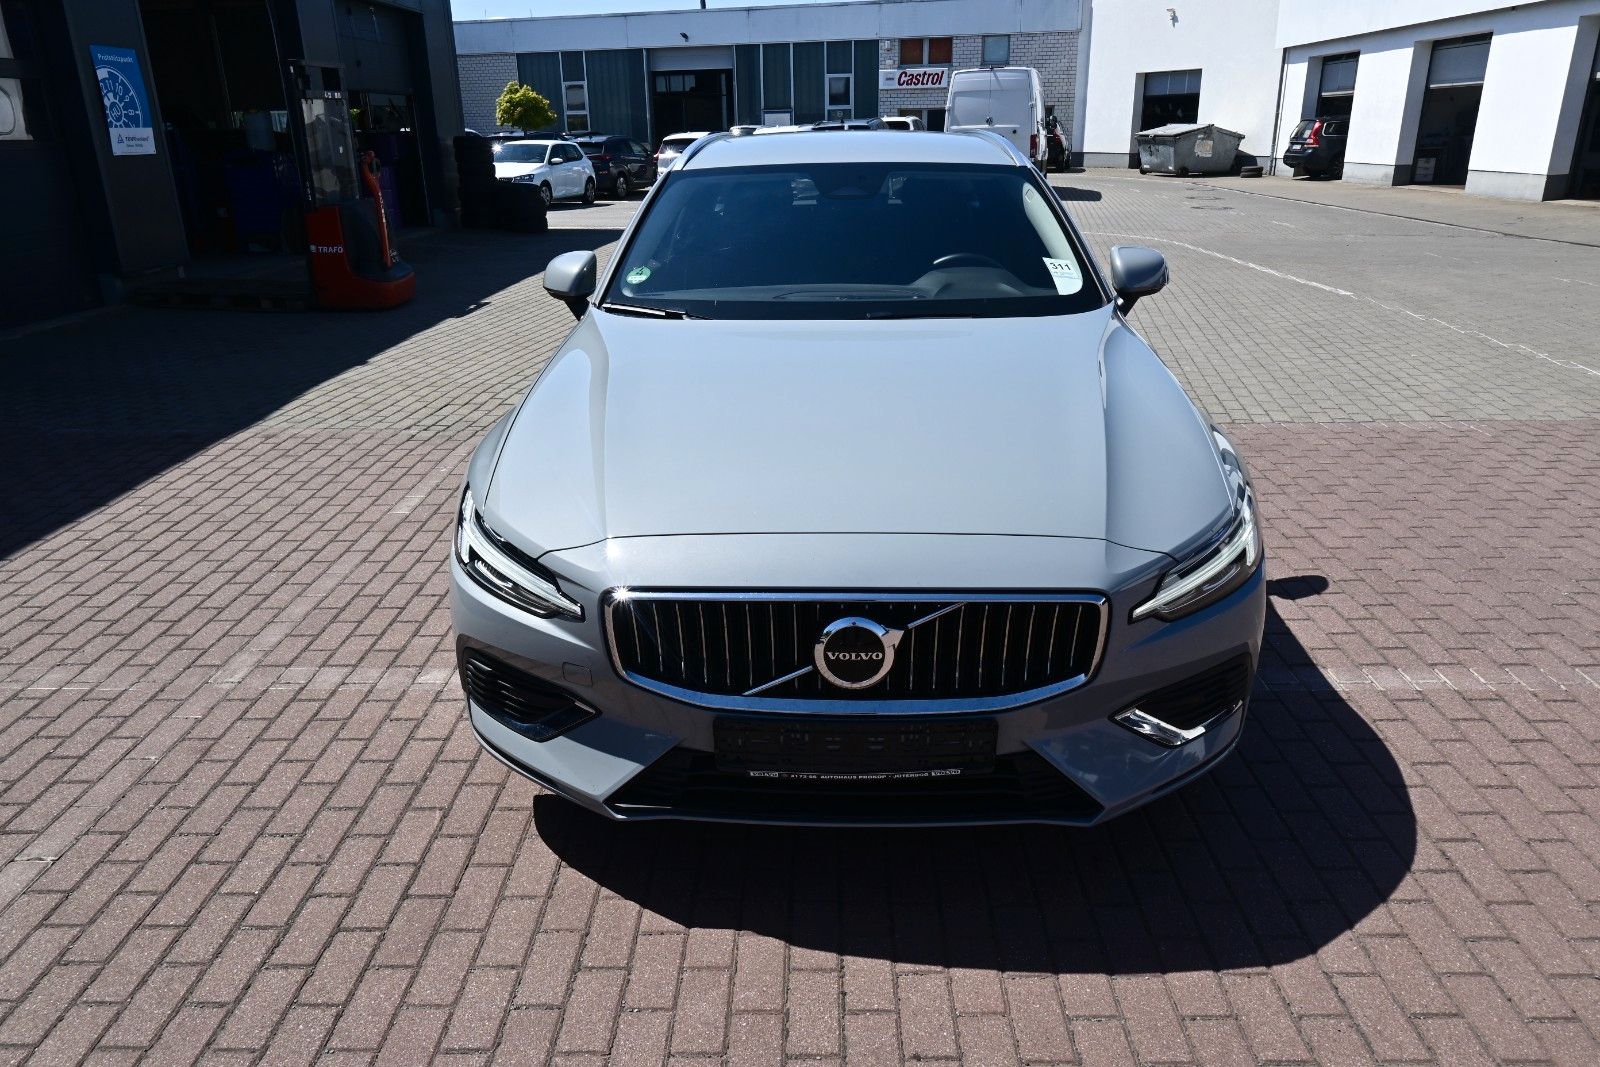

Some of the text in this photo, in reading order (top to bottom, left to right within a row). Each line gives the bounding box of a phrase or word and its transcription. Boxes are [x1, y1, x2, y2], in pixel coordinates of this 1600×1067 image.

[897, 70, 945, 87] Castrol
[115, 82, 123, 96] 10
[1050, 262, 1071, 271] 311
[826, 651, 883, 661] VOLVO
